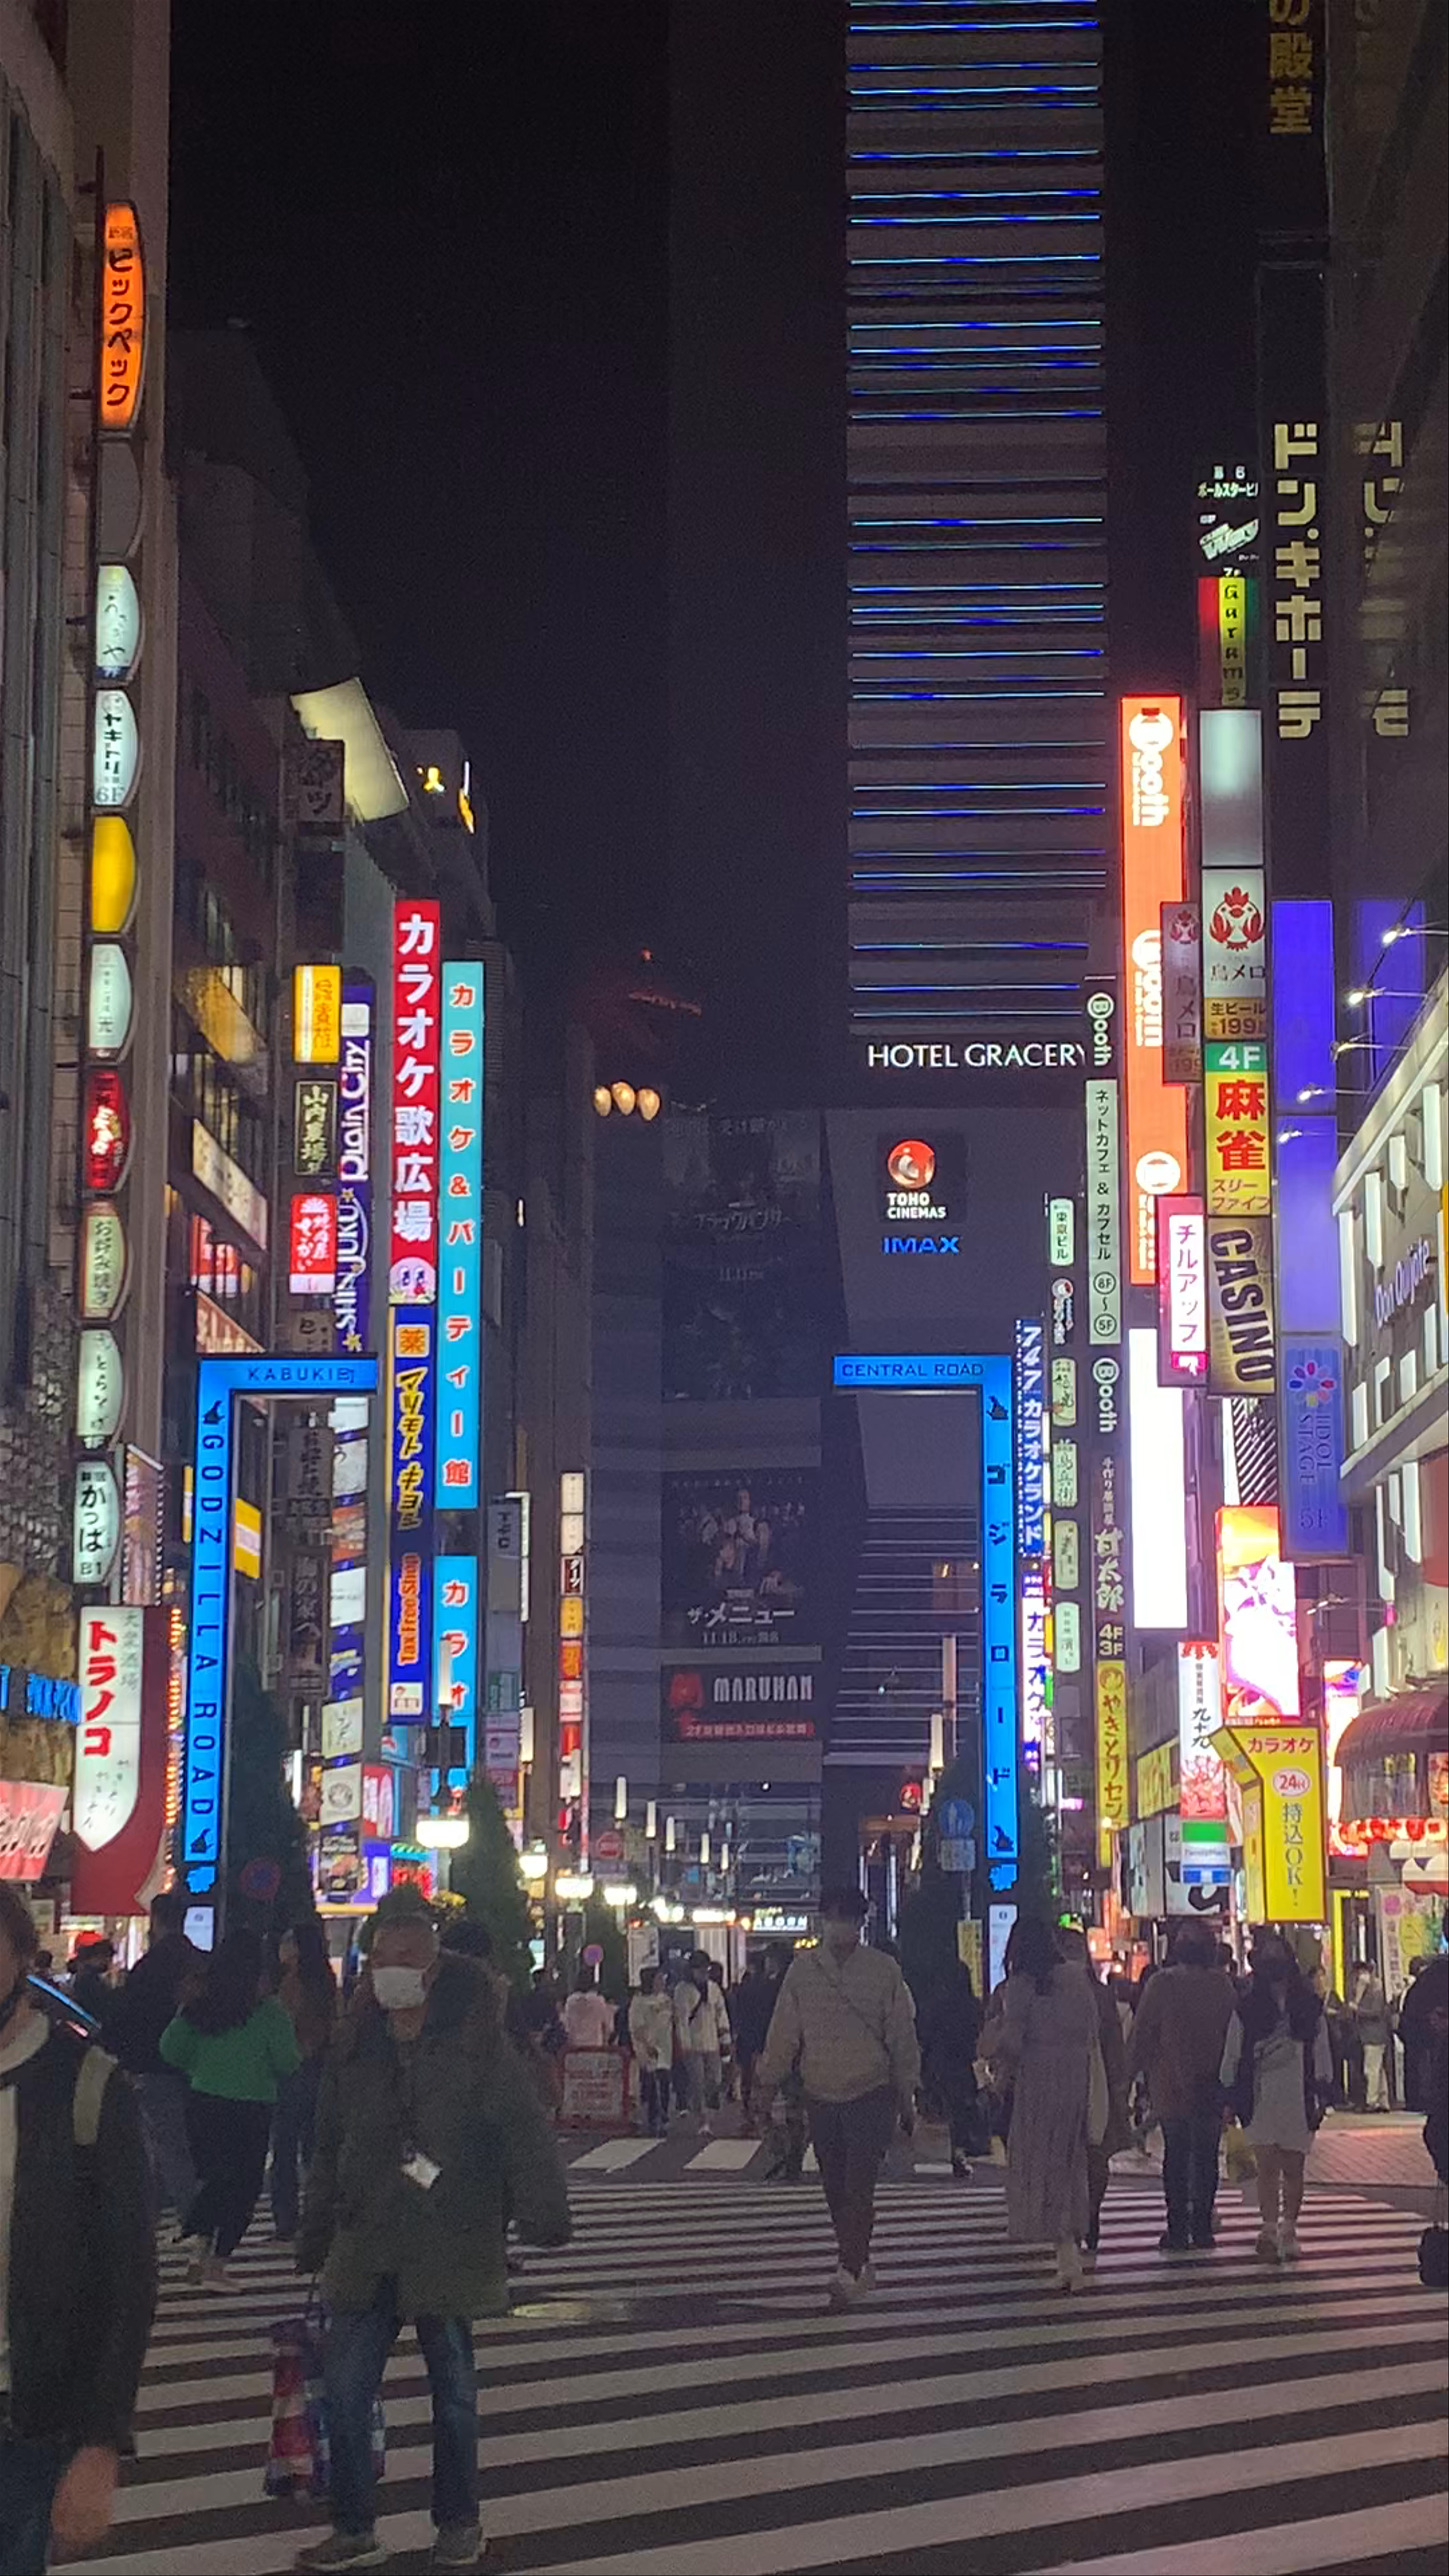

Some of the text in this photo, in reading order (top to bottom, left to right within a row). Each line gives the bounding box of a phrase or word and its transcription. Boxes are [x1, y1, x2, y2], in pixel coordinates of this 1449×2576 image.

[107, 248, 133, 406] ビックペック
[1211, 1003, 1266, 1016] 生ビール
[868, 1045, 958, 1067] HOTEL
[1219, 1046, 1260, 1070] 4F
[394, 914, 435, 1242] カラオケ歌広場
[1215, 1080, 1266, 1171] 麻雀
[1212, 1179, 1258, 1193] スリー
[887, 1193, 930, 1206] TOHO
[887, 1207, 946, 1220] CINEMAS
[882, 1237, 961, 1254] IMAX
[1211, 1229, 1276, 1383] CASINO
[400, 1327, 426, 1354] 薬
[842, 1363, 984, 1376] CENTRAL ROAD
[1093, 1358, 1120, 1432] Booth
[397, 1367, 423, 1530] マツモトキヨシ
[80, 1562, 101, 1575] B1
[191, 1435, 224, 1814] GODZILLA ROAD
[986, 1463, 1011, 1785] ゴジラロード
[1099, 1623, 1123, 1639] 4F
[1099, 1640, 1123, 1656] 3F
[84, 1621, 118, 1757] トラノコ
[714, 1675, 812, 1702] MARUHAN
[1248, 1737, 1315, 1754] カラオケ
